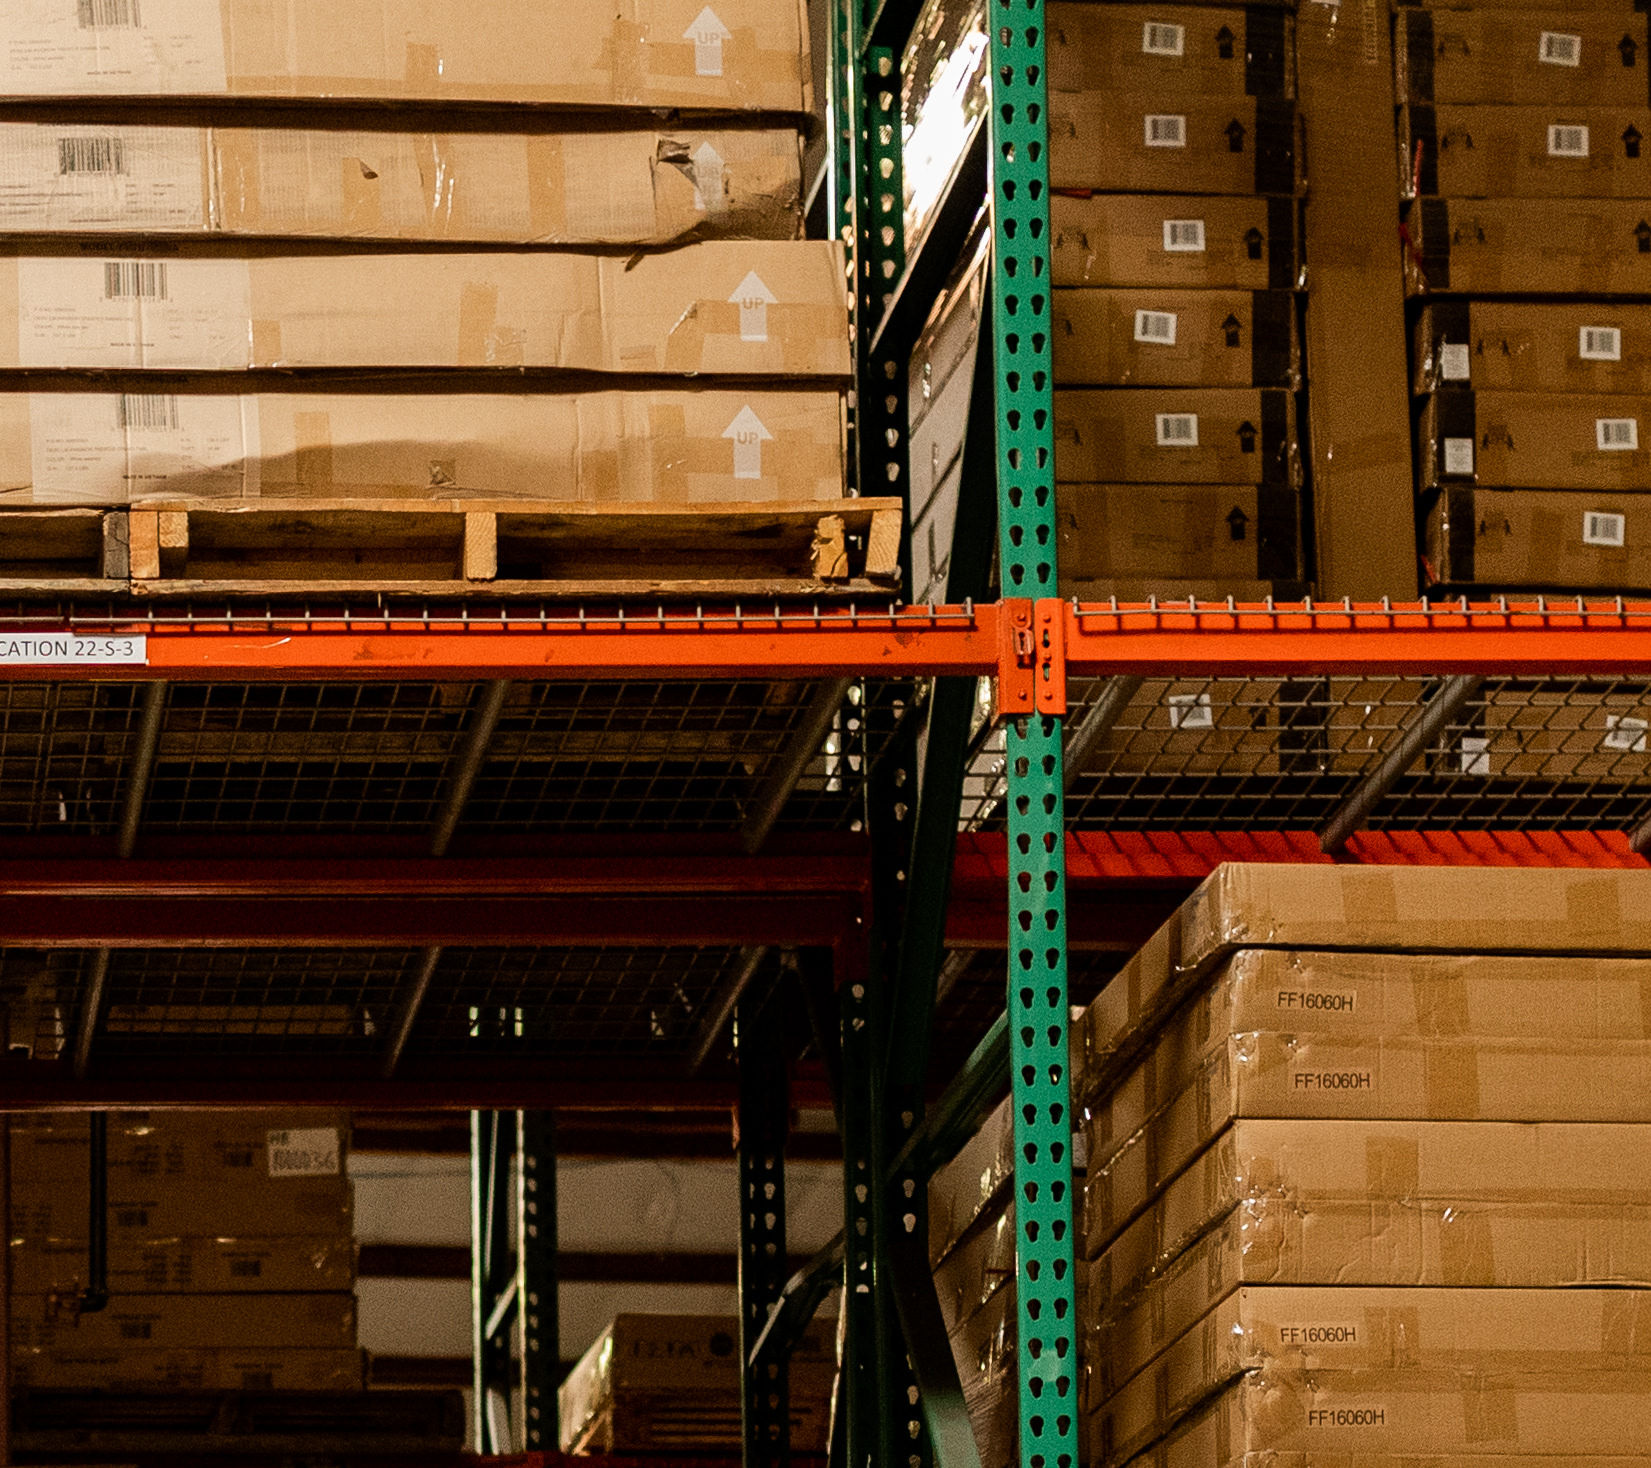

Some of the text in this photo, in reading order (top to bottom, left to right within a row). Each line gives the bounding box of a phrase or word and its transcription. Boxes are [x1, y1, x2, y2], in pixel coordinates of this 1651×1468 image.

[697, 32, 719, 44] UP
[741, 297, 763, 310] UP
[736, 431, 758, 444] UP
[75, 640, 134, 658] 22-S-3
[1278, 991, 1352, 1010] FF16060H
[1295, 1073, 1370, 1089] FF16060H
[1280, 1327, 1356, 1343] FF16060H
[1309, 1410, 1384, 1426] FF16060H
